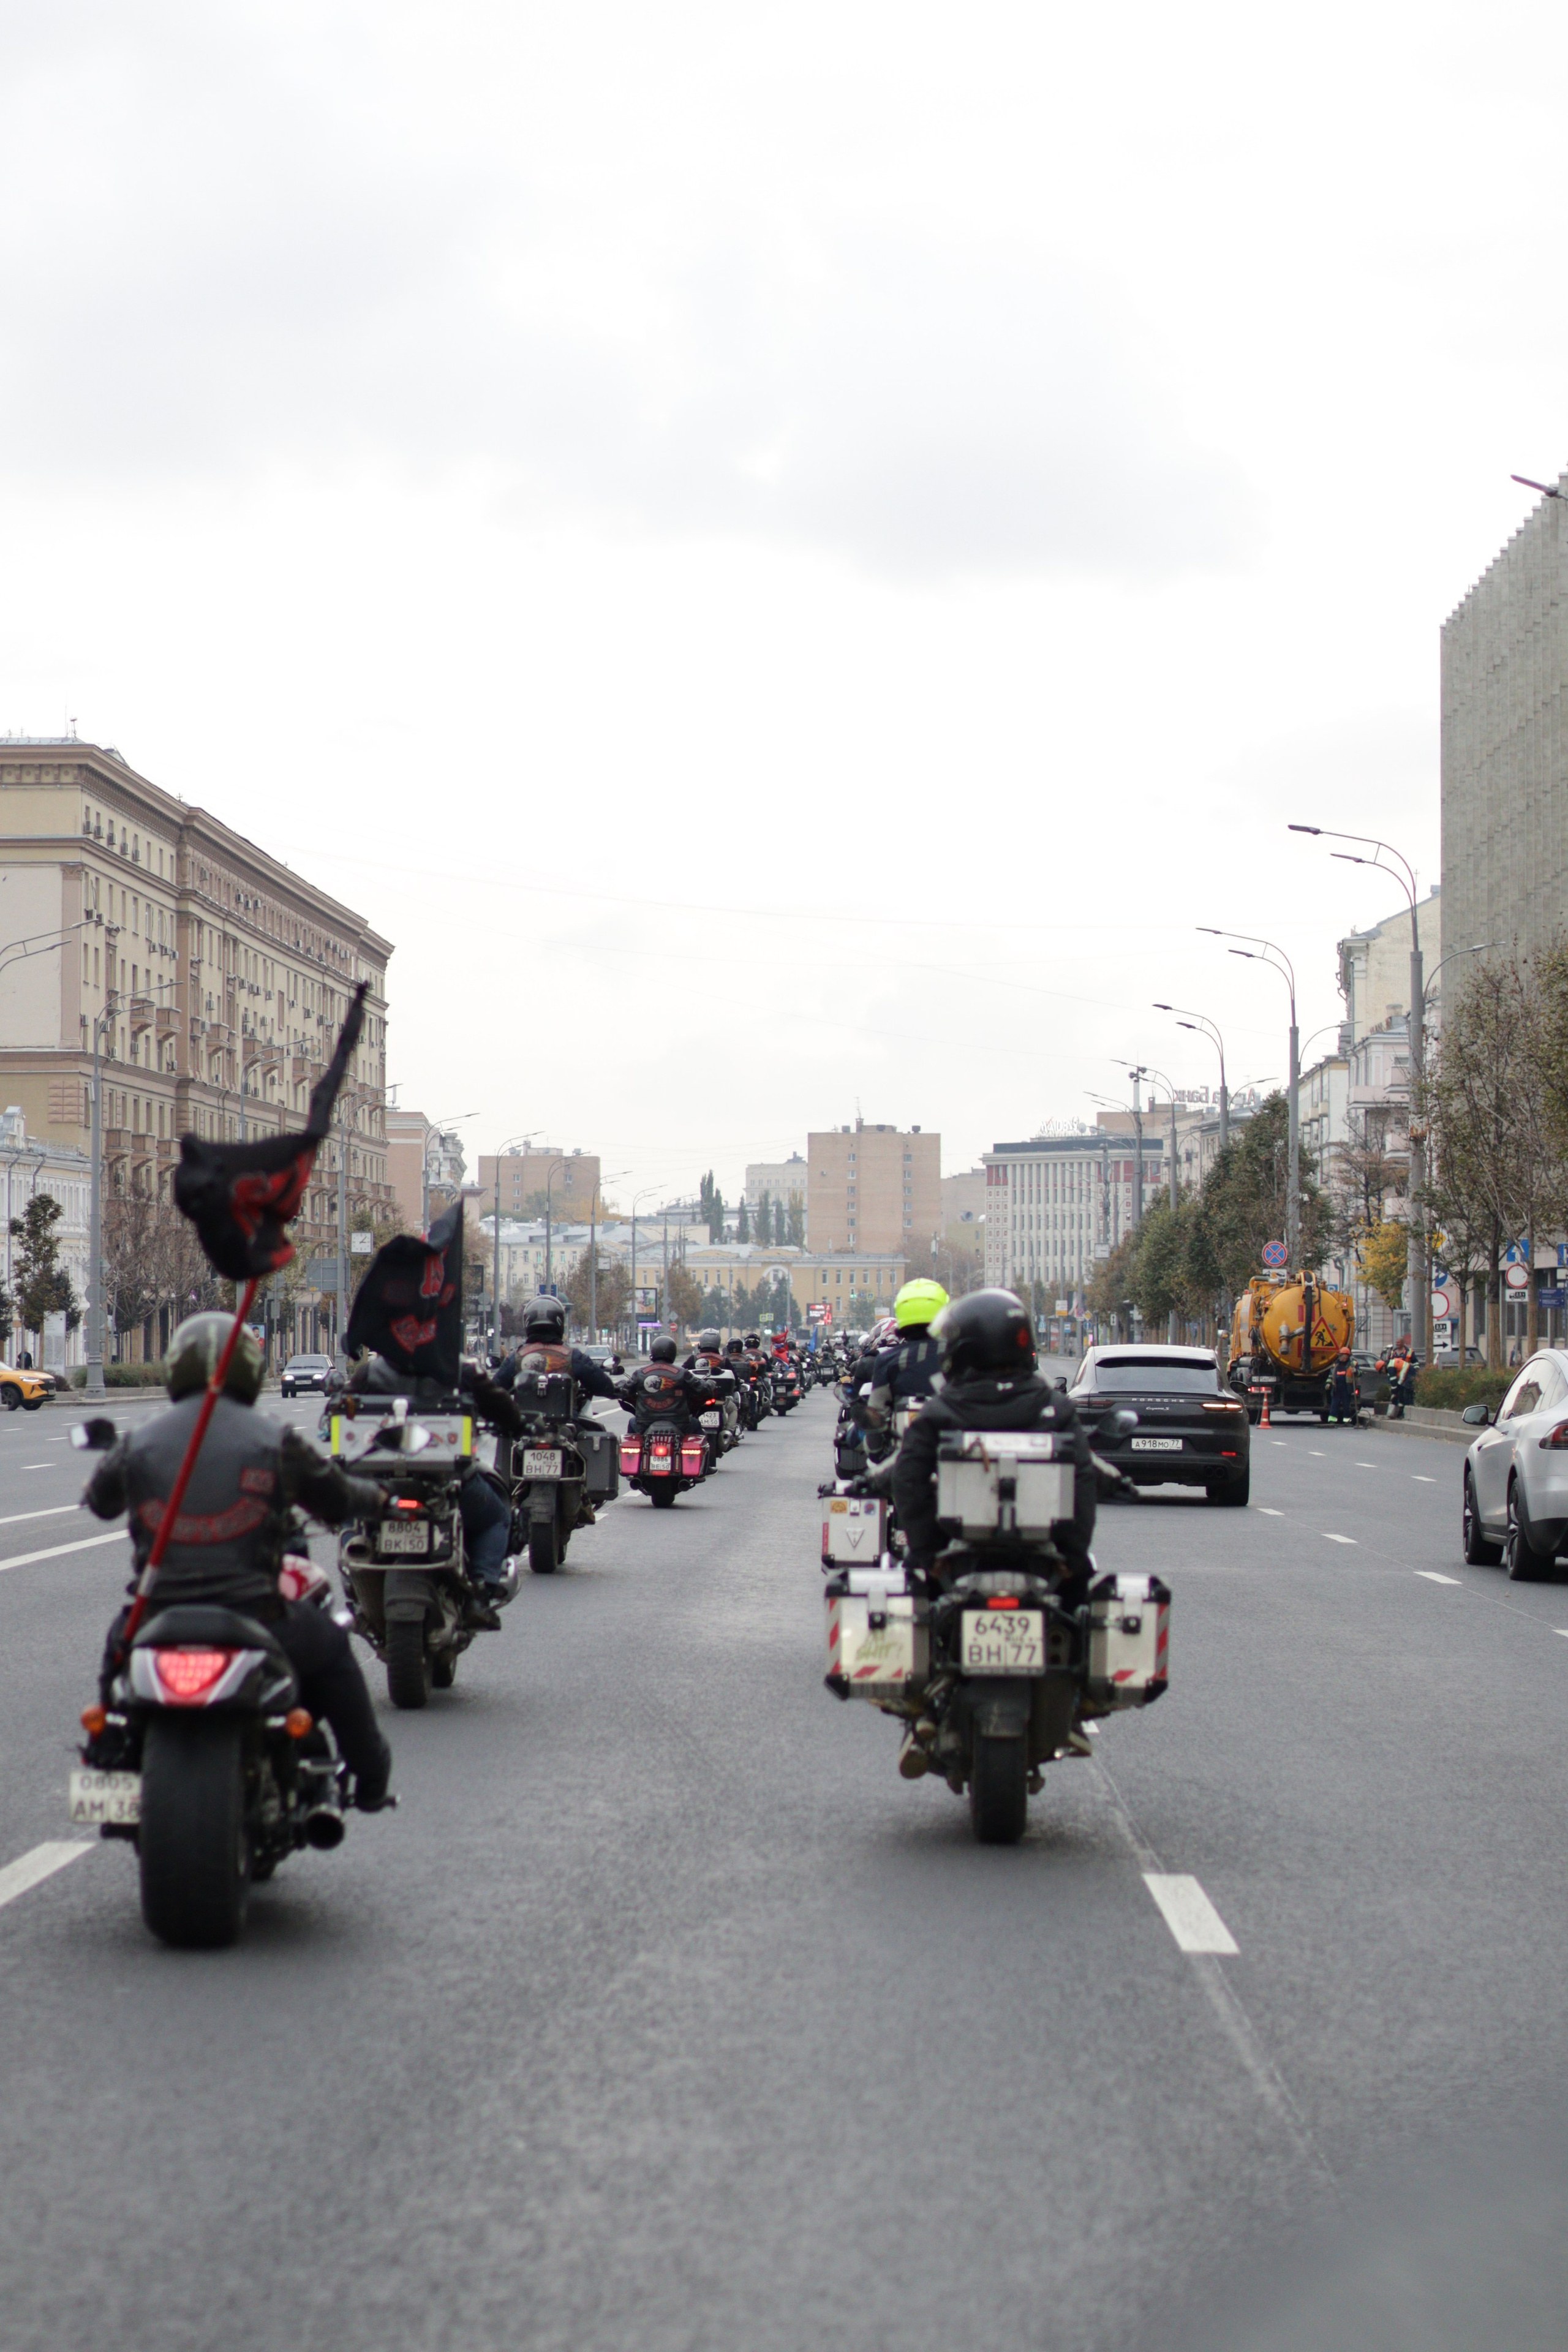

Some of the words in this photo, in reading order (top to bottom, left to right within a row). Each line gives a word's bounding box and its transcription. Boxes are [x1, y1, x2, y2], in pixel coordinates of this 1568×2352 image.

[530, 1452, 556, 1461] 1048
[526, 1464, 542, 1474] BH
[545, 1464, 559, 1474] 77
[409, 1539, 424, 1550] 50
[974, 1615, 1030, 1635] 6439
[968, 1644, 1001, 1663] BH
[1011, 1644, 1037, 1663] 77
[74, 1800, 104, 1822] AM
